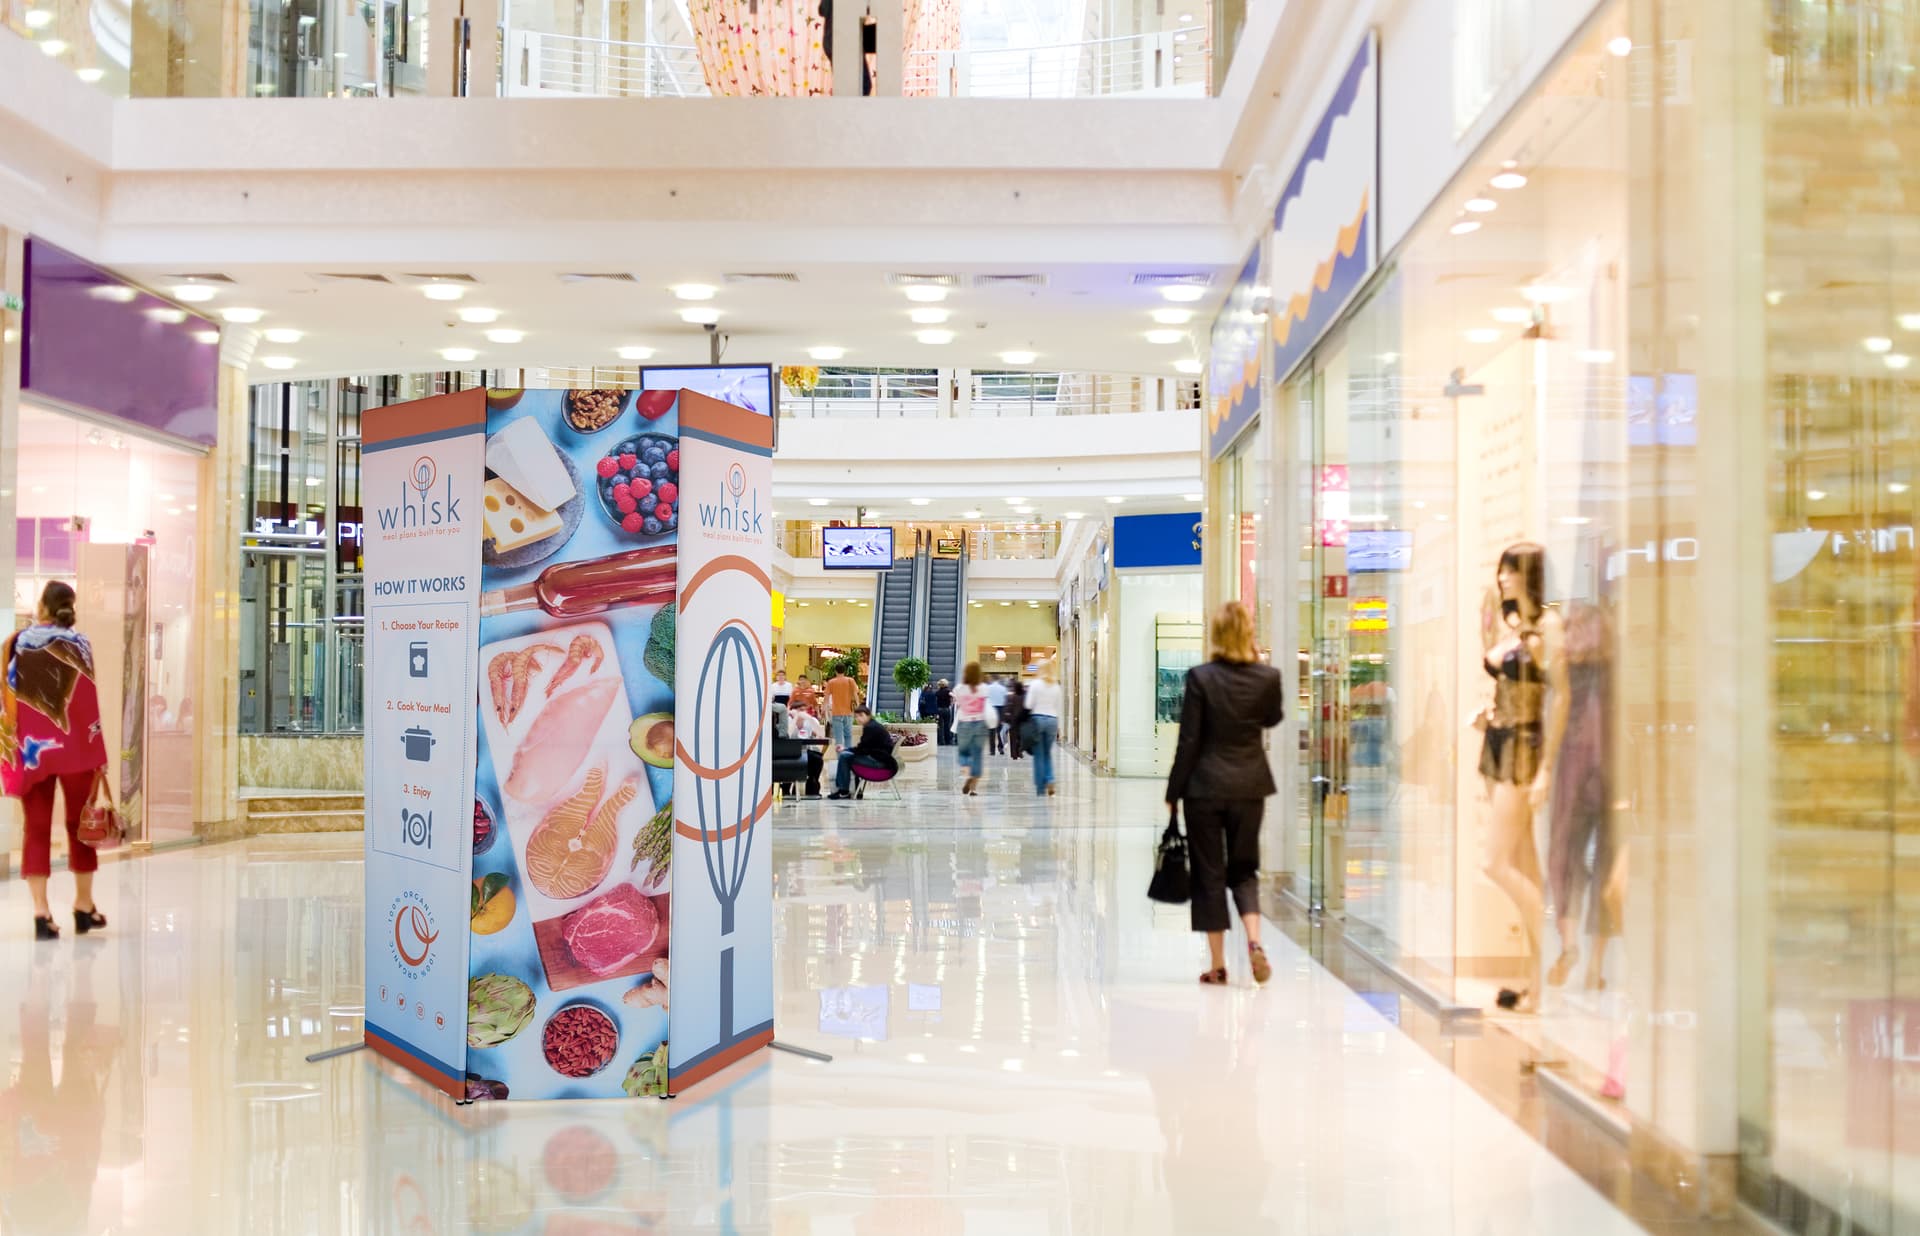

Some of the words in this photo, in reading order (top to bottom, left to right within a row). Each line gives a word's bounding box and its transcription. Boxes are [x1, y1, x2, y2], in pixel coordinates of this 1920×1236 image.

[378, 473, 461, 530] whisk
[699, 481, 762, 534] whisk
[400, 529, 416, 541] plans
[419, 526, 434, 537] built
[436, 525, 446, 535] for
[448, 526, 461, 536] you
[374, 580, 405, 596] HOW
[407, 579, 417, 594] IT
[419, 576, 466, 592] WORKS
[382, 621, 388, 631] 1.
[391, 620, 416, 630] Choose
[417, 620, 434, 629] Your
[435, 619, 460, 631] Recipe
[386, 700, 394, 710] 2.
[396, 701, 415, 711] Cook
[416, 702, 432, 713] Your
[433, 703, 451, 714] Meal
[403, 783, 410, 794] 3.
[412, 785, 432, 800] Enjoy
[403, 890, 435, 925] ORGANIC
[389, 941, 418, 980] ORGANIC
